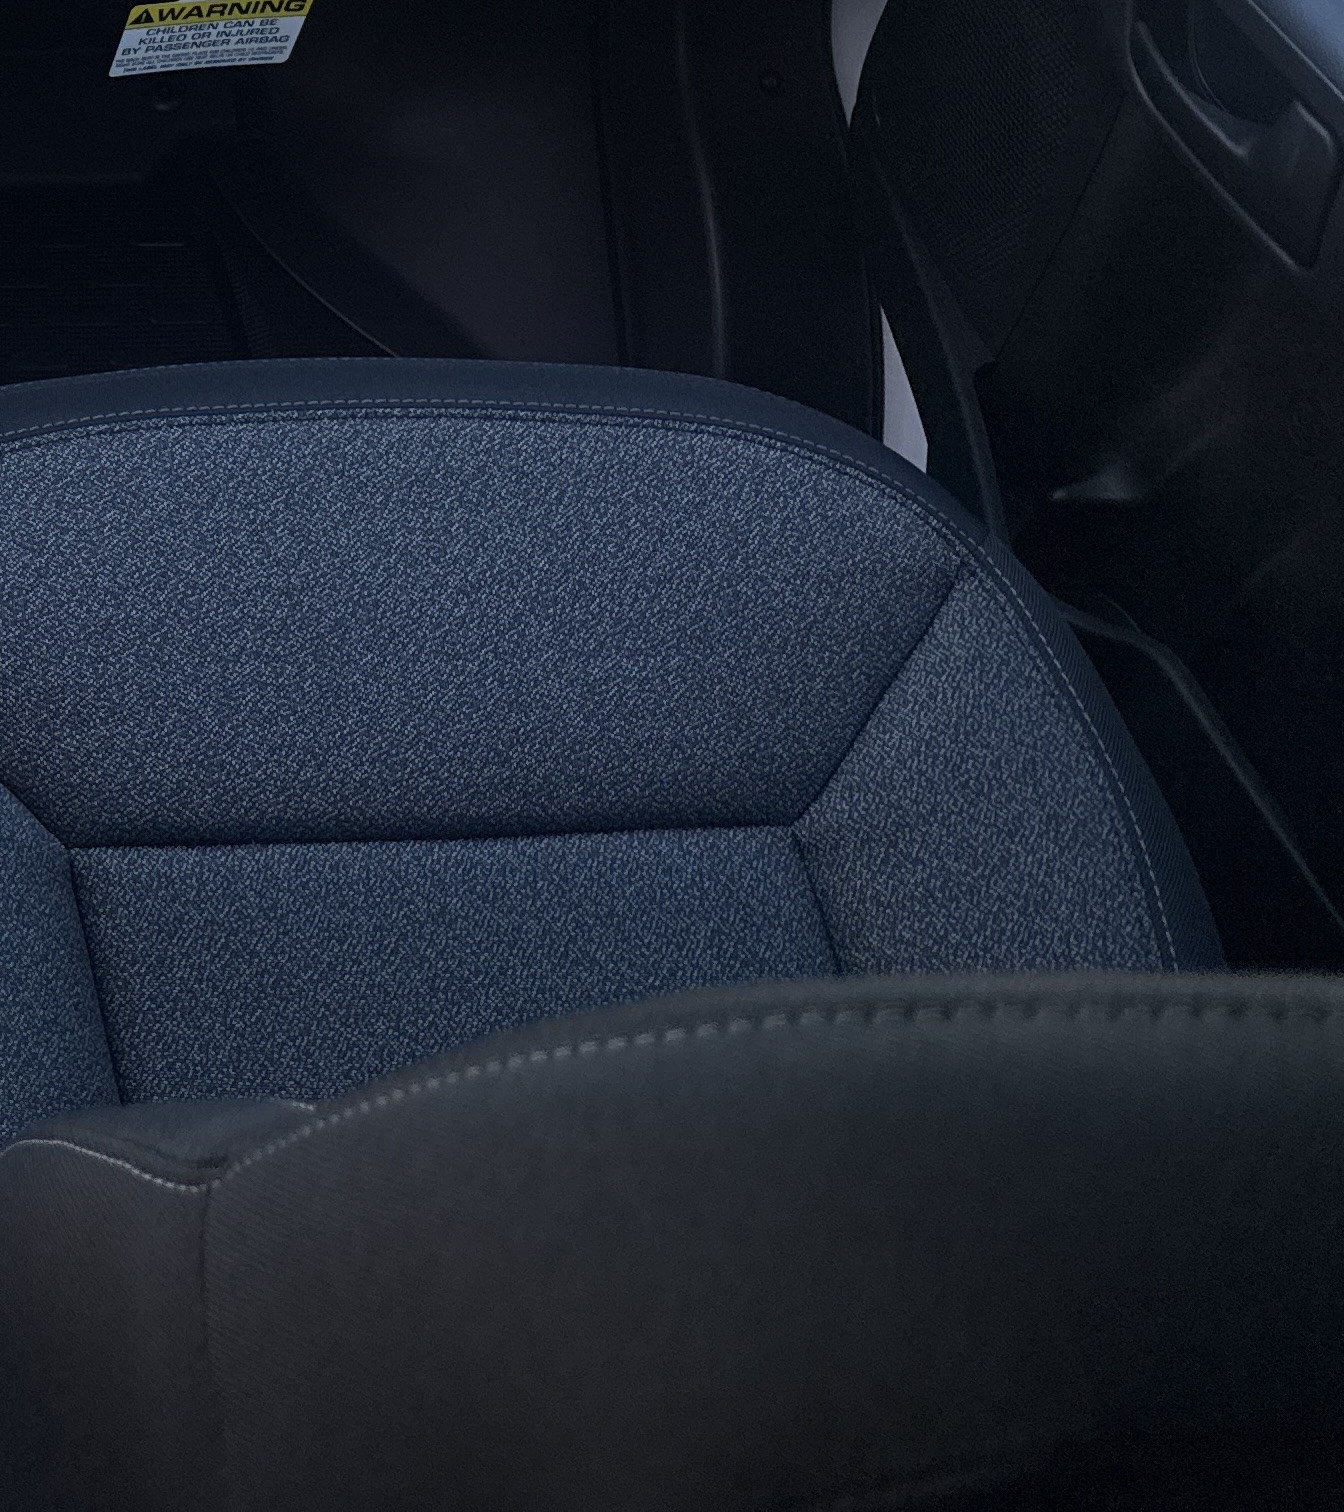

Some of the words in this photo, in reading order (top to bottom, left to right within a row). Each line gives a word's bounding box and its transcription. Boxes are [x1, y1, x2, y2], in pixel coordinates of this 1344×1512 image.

[138, 34, 188, 46] KILLED
[191, 32, 213, 41] OR
[215, 27, 280, 38] INJURED
[146, 21, 219, 36] CHILDREN
[223, 19, 255, 30] CAN
[259, 18, 279, 28] BE
[121, 47, 142, 56] BY
[144, 38, 231, 54] PASSENGER
[235, 34, 291, 46] AIRBAG
